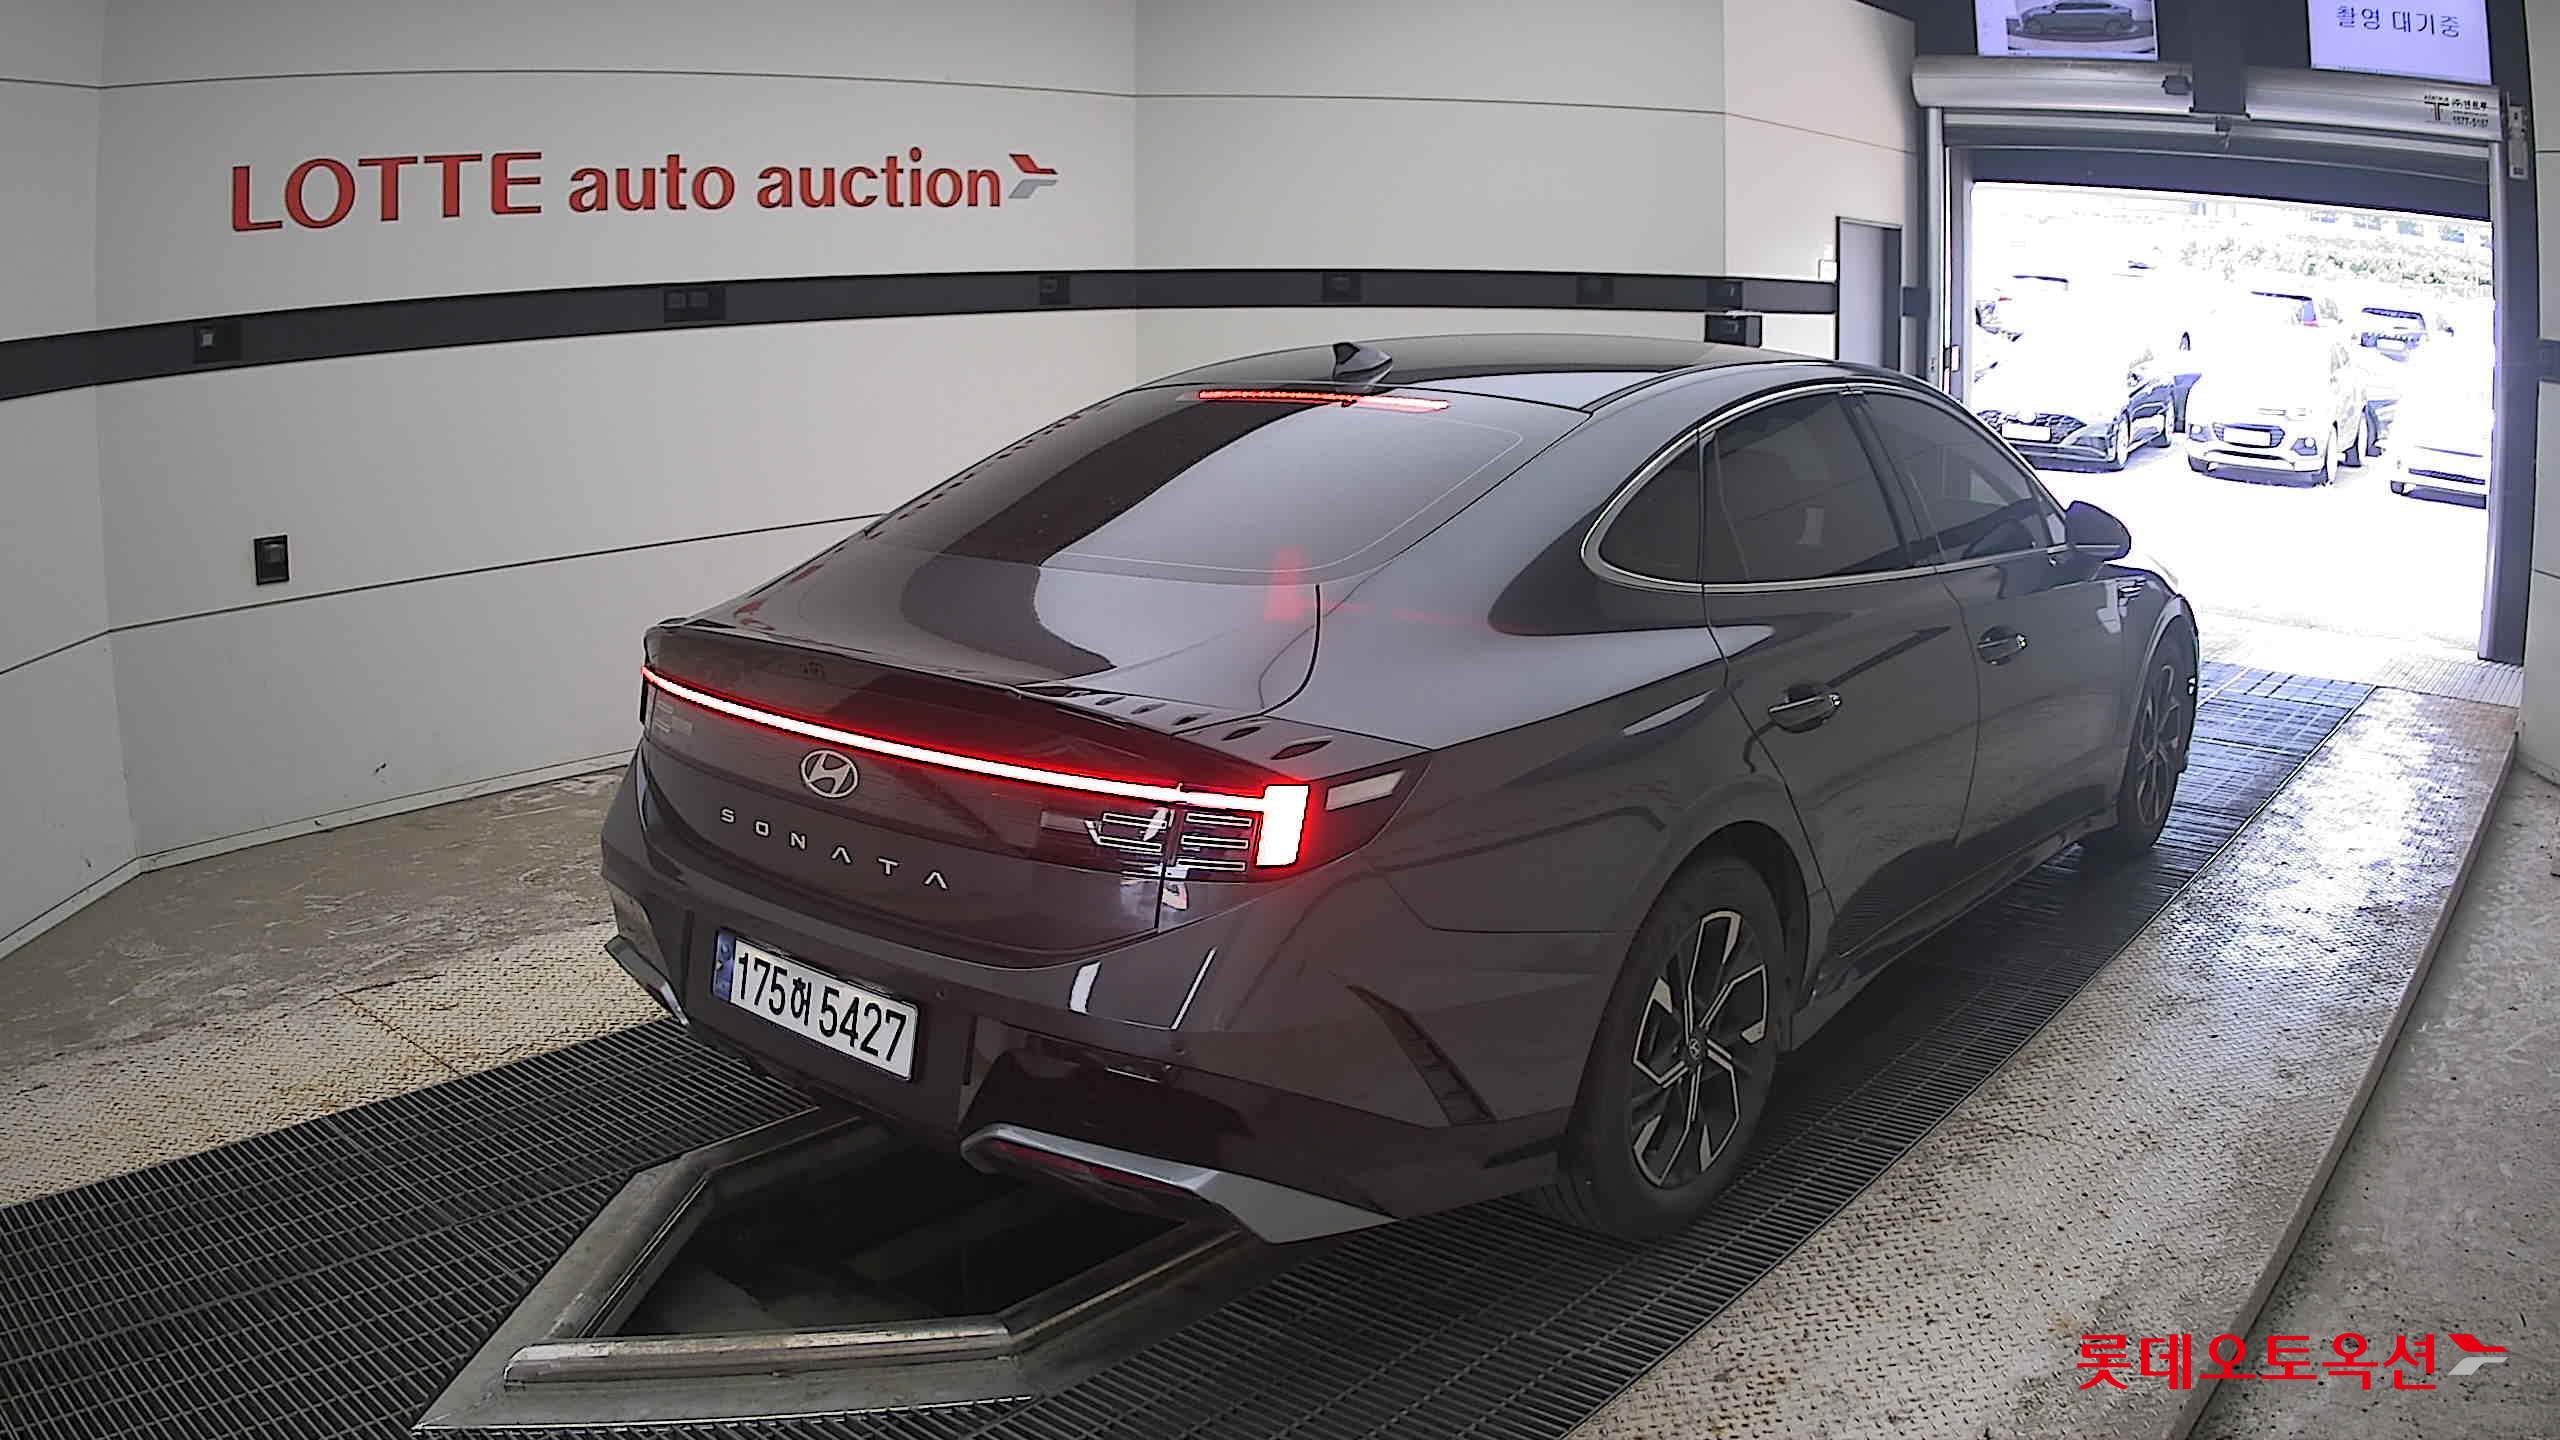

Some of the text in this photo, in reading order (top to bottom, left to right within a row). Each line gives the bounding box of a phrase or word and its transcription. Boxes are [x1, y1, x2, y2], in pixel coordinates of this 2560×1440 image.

[2337, 6, 2460, 39] 촬영 대기중
[232, 146, 1001, 231] LOTTE auto auction
[720, 807, 949, 890] SONATA
[819, 986, 907, 1063] 5427
